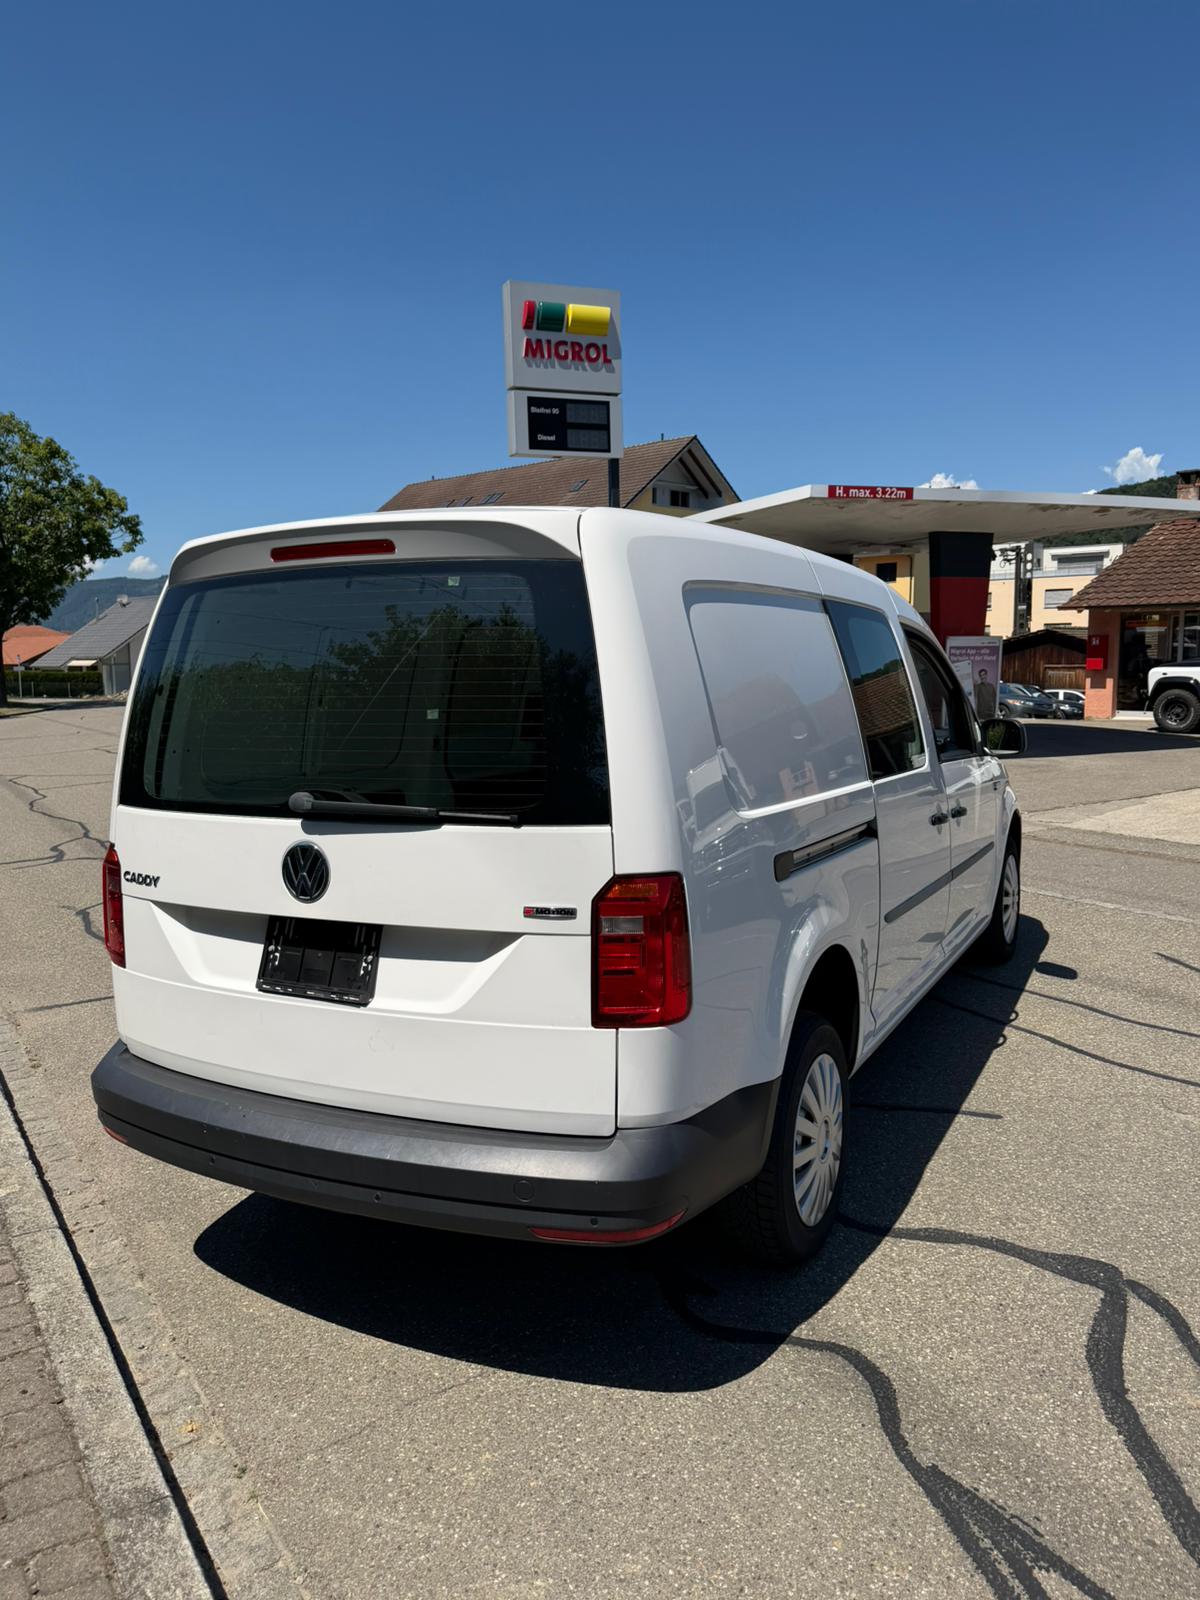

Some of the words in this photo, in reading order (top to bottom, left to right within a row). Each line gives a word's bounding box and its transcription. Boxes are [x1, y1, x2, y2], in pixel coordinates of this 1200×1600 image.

[523, 337, 612, 363] MIGROL
[530, 406, 551, 414] Bleifrei
[552, 407, 559, 415] 95
[537, 433, 556, 441] Diesel
[836, 486, 847, 497] H.
[849, 488, 873, 498] max.
[876, 487, 906, 498] 3.22m
[123, 870, 160, 888] CADDY
